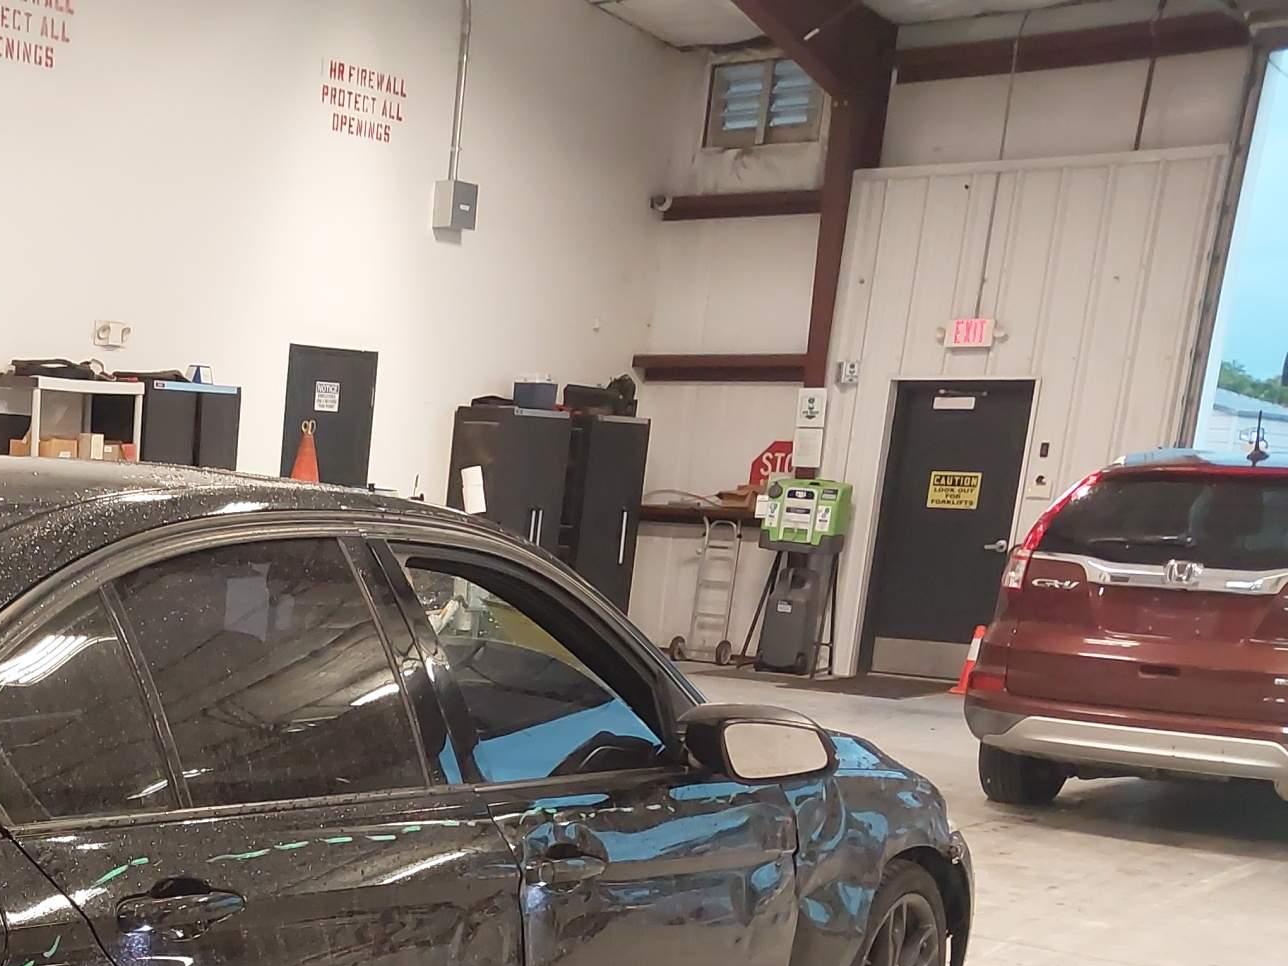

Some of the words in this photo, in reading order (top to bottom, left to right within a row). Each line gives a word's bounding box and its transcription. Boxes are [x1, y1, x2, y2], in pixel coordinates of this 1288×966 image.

[40, 16, 70, 43] ALL
[329, 59, 345, 81] HR
[348, 65, 407, 98] FIREWALL
[321, 84, 377, 115] PROTECT
[381, 99, 403, 122] ALL
[331, 112, 391, 143] OPENINGS
[954, 319, 987, 344] EXIT
[759, 452, 793, 476] STO
[934, 475, 978, 487] CAUTION
